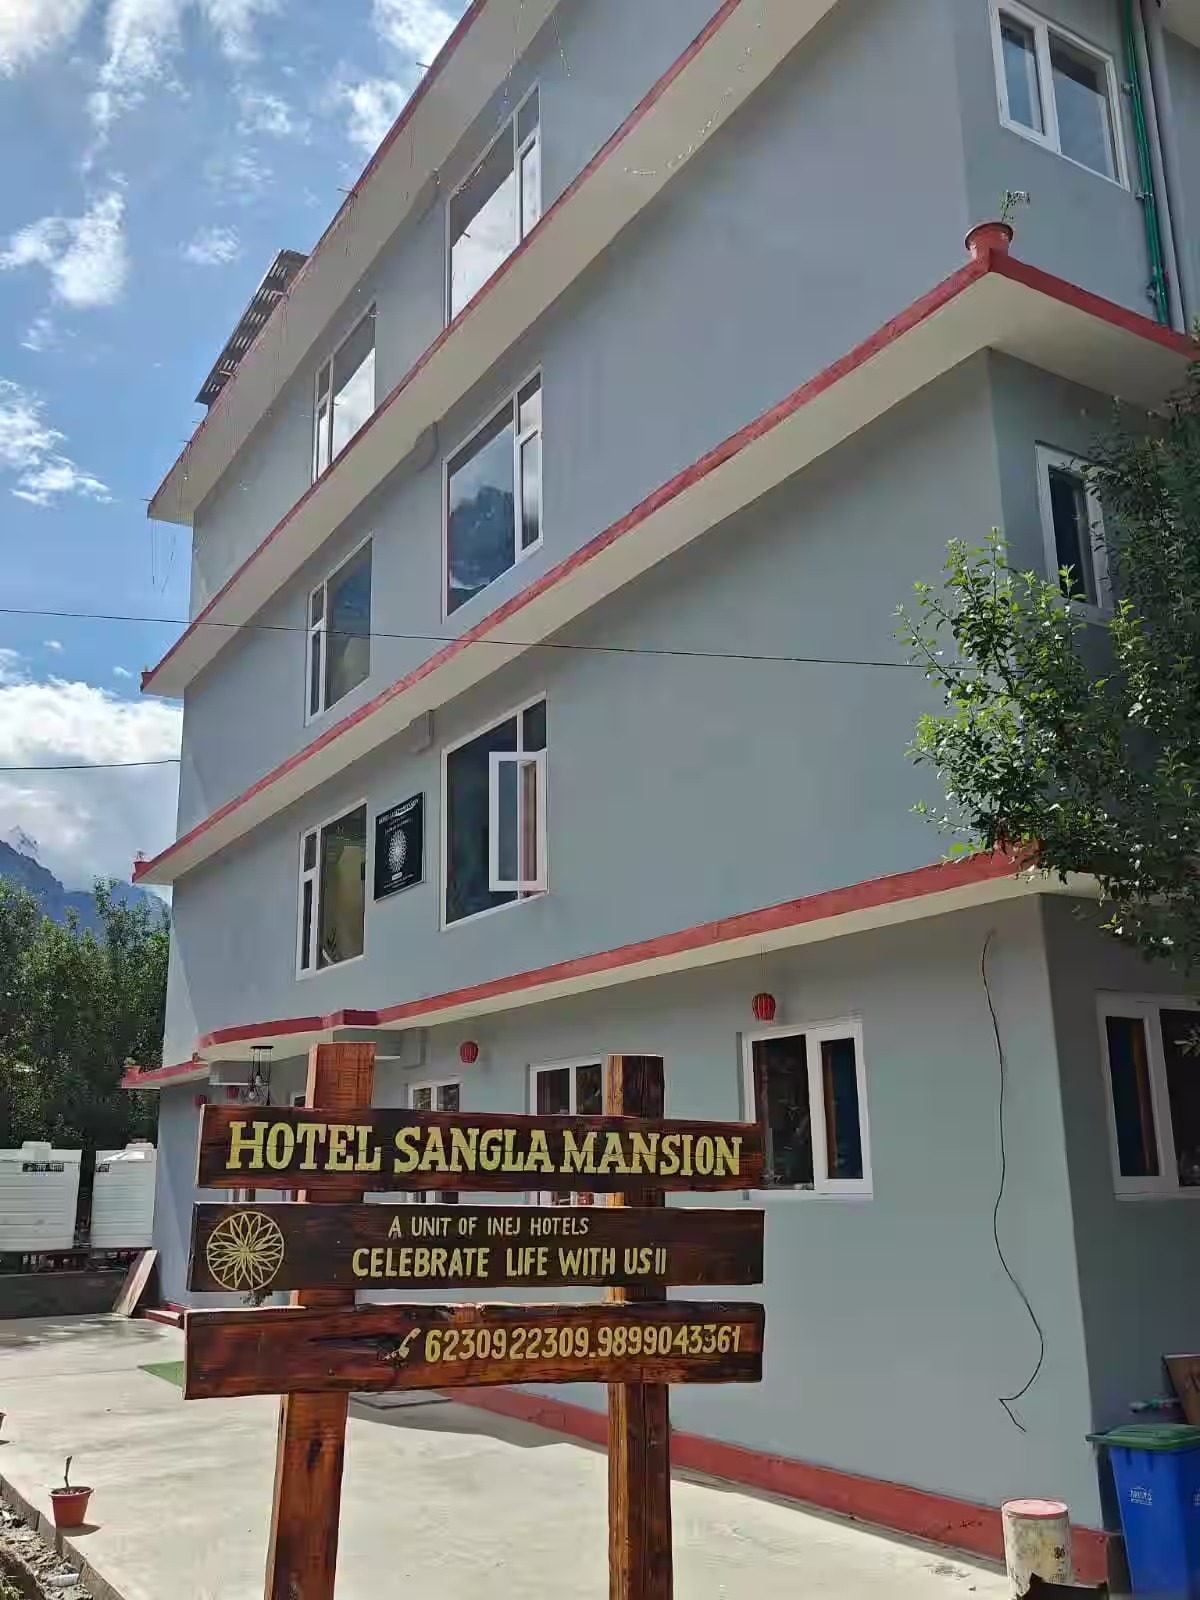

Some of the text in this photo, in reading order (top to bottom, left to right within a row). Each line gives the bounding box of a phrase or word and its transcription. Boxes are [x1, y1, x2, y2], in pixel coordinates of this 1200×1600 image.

[225, 1121, 743, 1176] HOTEL SANGLA MANSION
[388, 1215, 590, 1238] A UNIT OF INEJ HOTELS
[352, 1247, 490, 1278] CELEBRATE
[506, 1247, 549, 1277] LIFE
[558, 1247, 616, 1277] WITH
